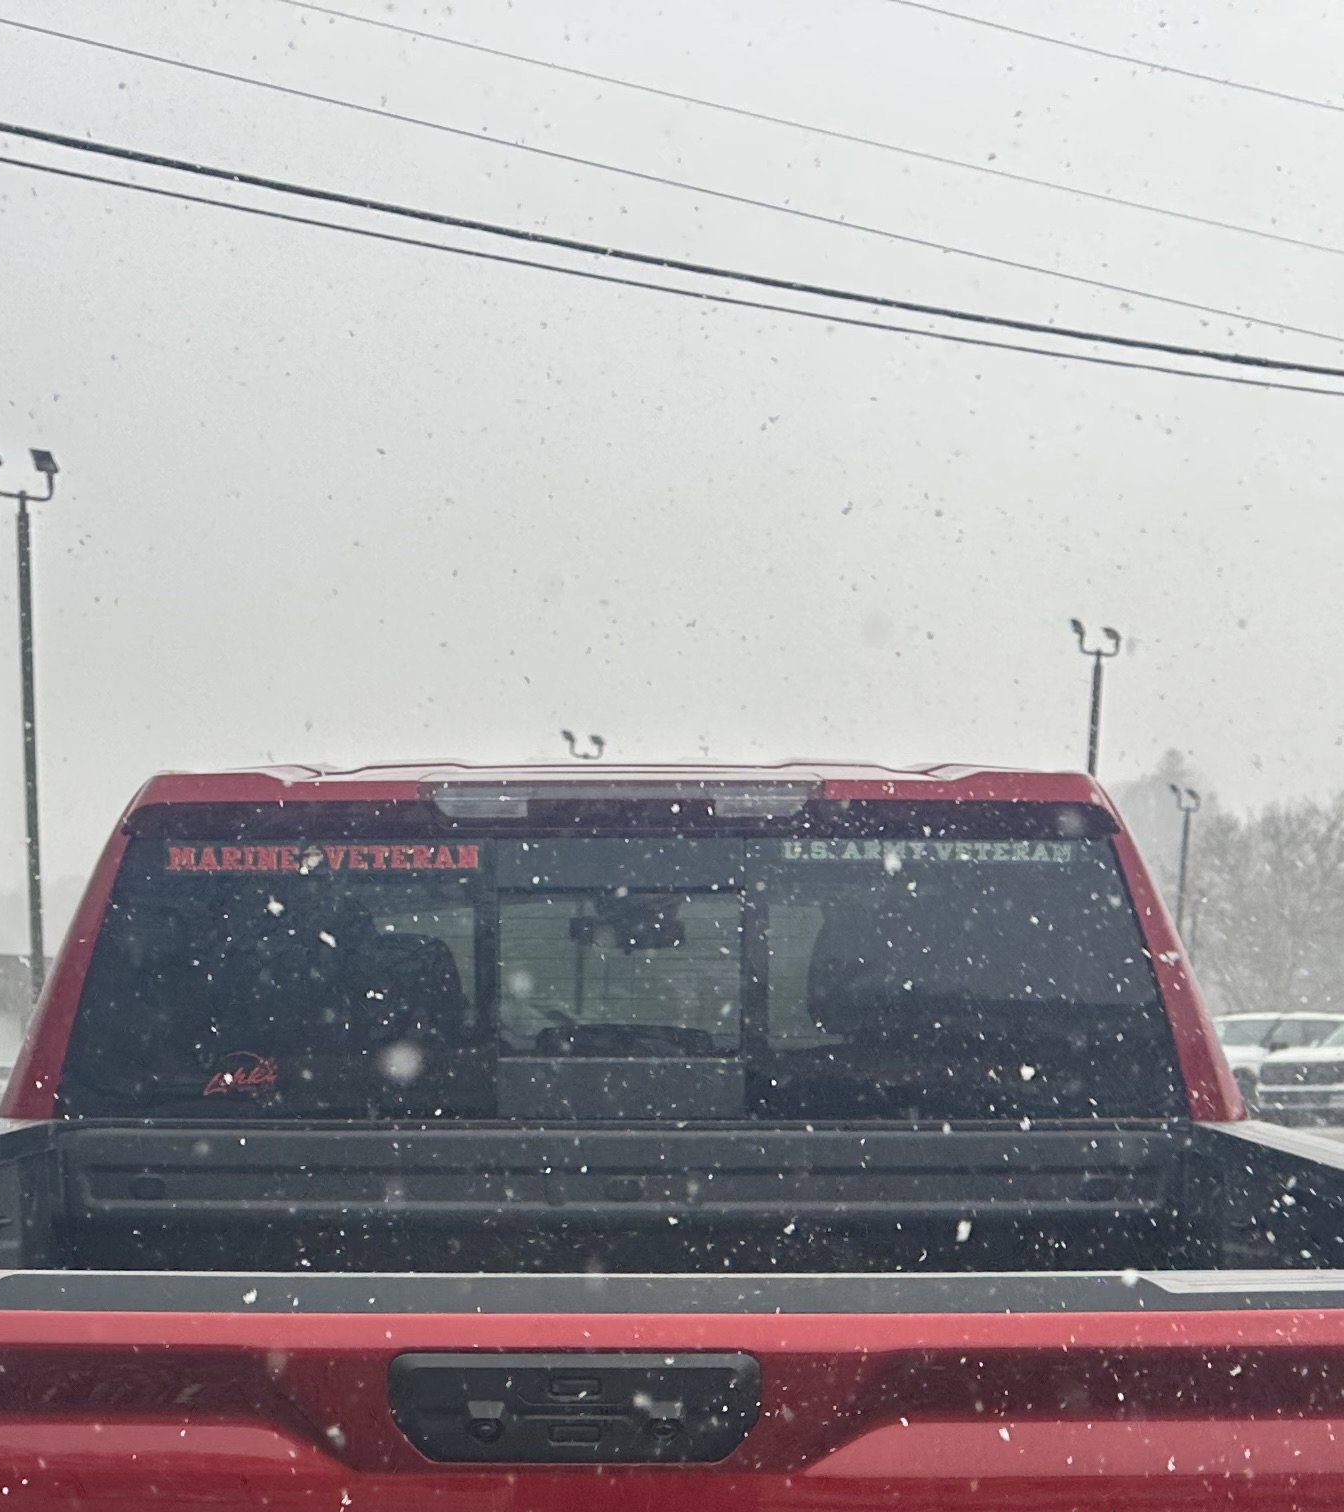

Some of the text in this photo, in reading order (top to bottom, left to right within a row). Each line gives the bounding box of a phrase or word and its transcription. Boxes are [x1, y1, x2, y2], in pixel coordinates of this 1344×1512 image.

[166, 845, 480, 872] MARINE VETERAN
[783, 841, 835, 860] U.S.
[935, 842, 1072, 862] VETERAN
